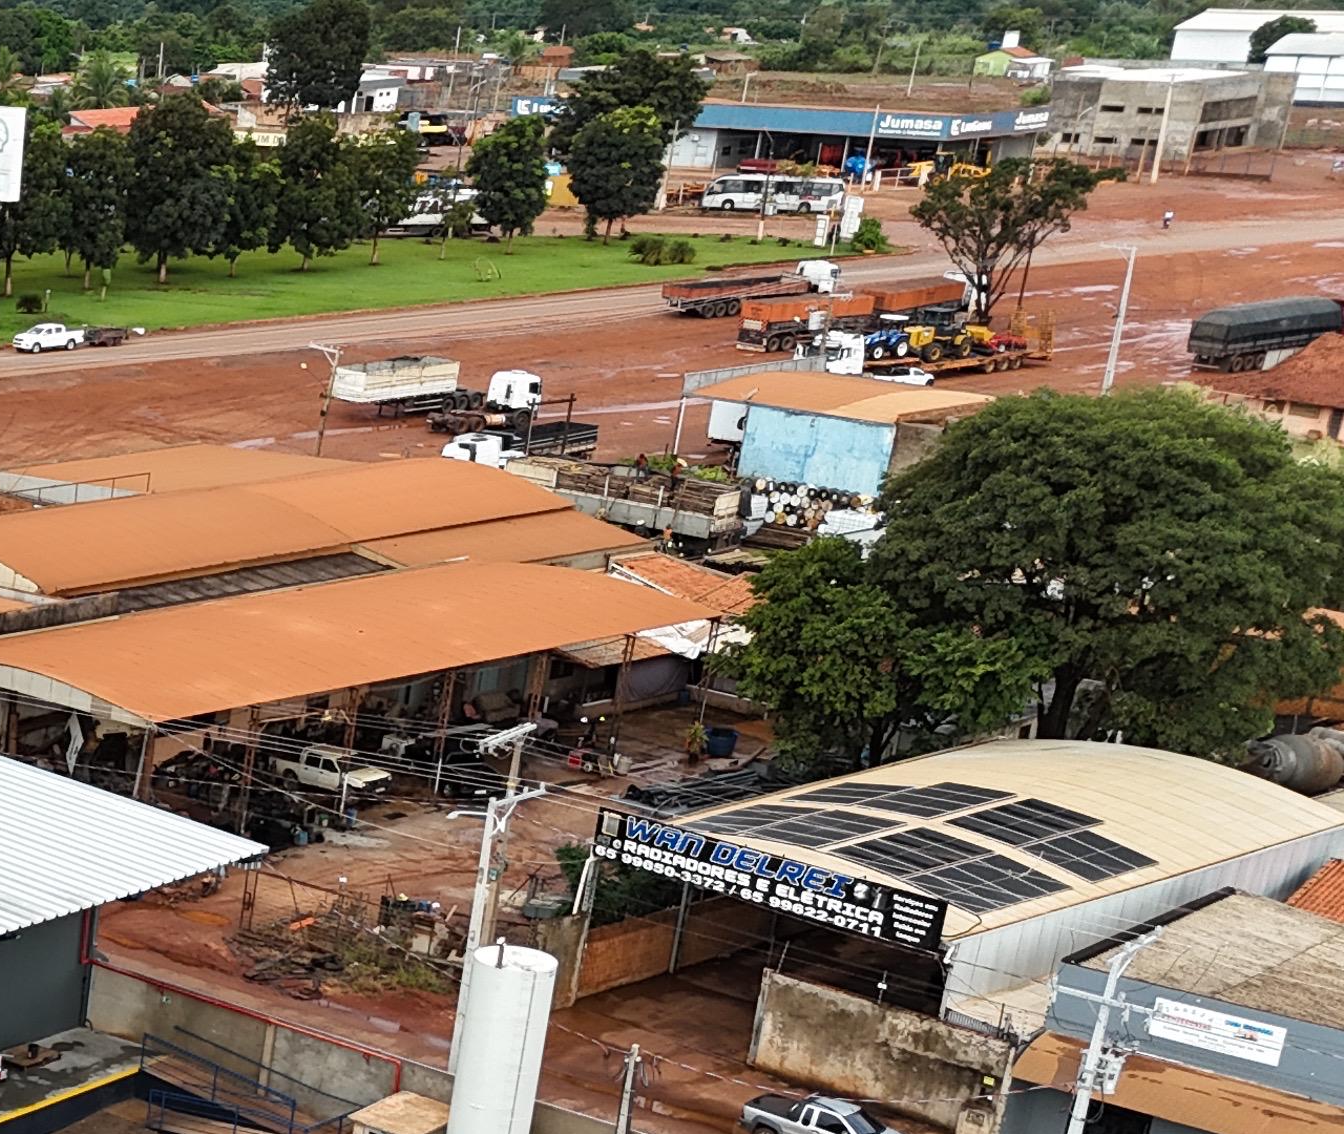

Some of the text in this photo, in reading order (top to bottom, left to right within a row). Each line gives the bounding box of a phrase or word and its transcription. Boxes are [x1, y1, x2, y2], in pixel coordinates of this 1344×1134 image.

[880, 115, 943, 130] Jumasa
[623, 840, 752, 887] RADIADORES
[756, 878, 771, 892] E
[626, 816, 854, 899] WAN DELREI
[595, 845, 617, 859] 65
[621, 852, 726, 892] 99650-3372
[740, 888, 764, 903] 65
[769, 896, 882, 938] 99622-0711
